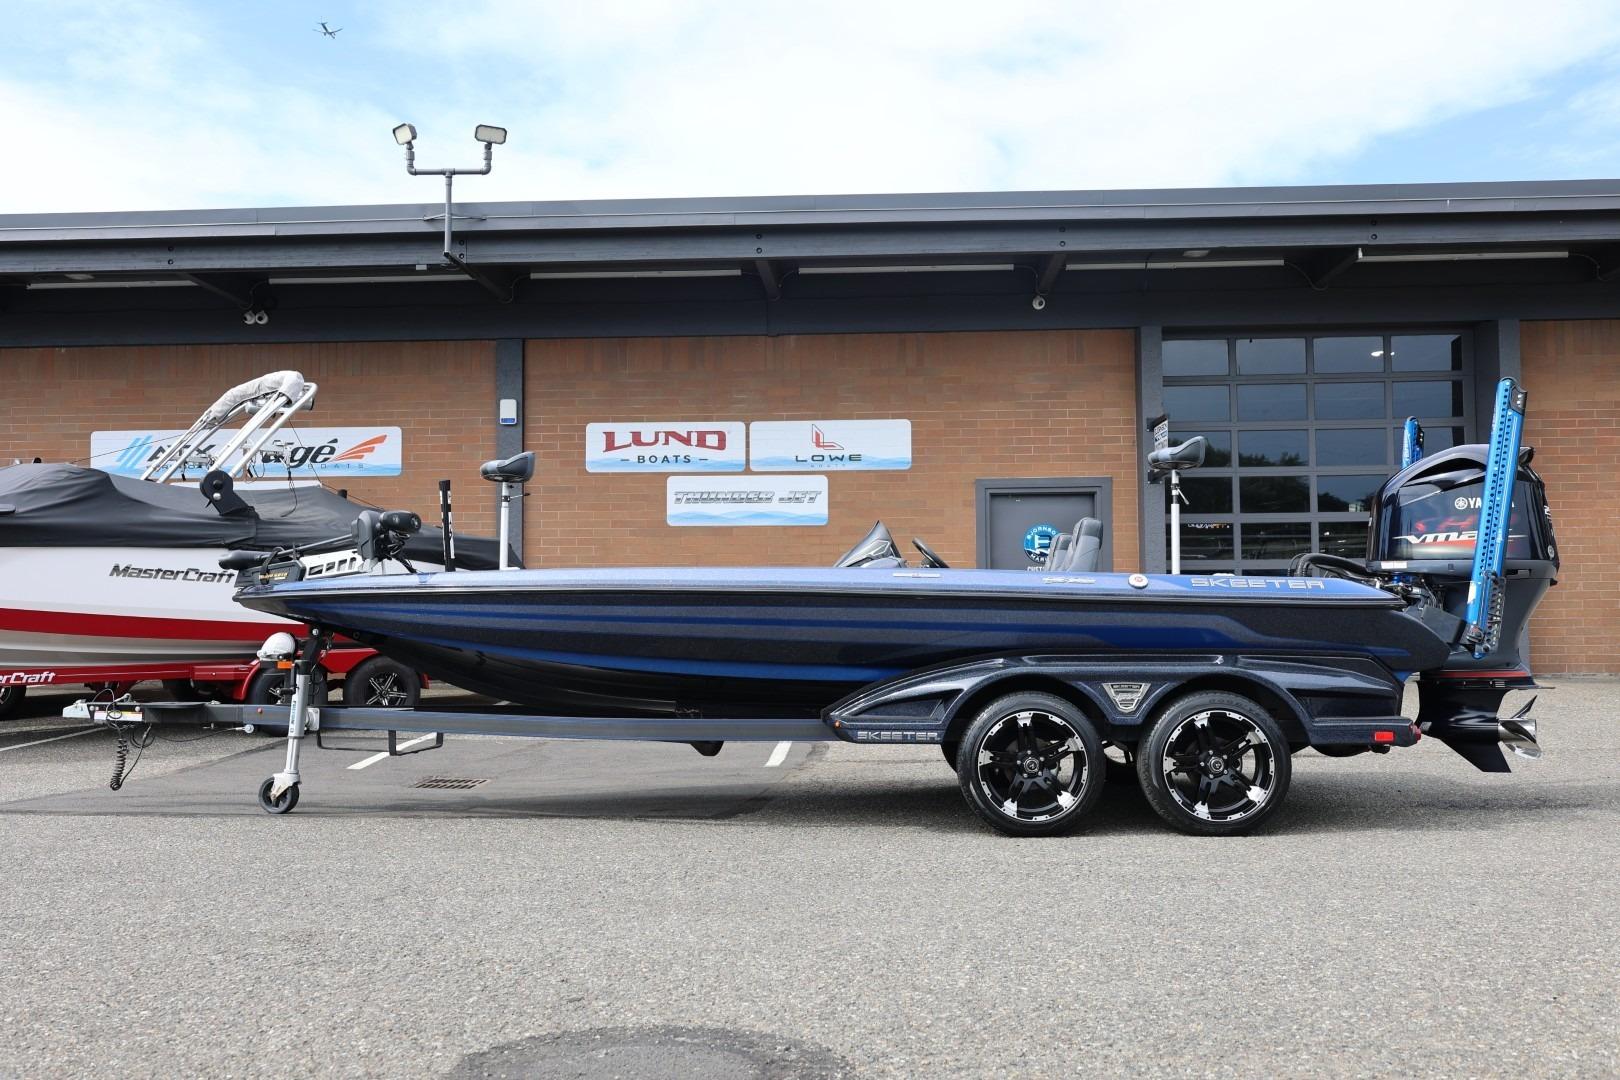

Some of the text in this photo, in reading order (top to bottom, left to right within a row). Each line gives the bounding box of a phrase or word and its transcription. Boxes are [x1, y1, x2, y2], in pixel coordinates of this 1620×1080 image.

[603, 431, 727, 452] LUND
[637, 455, 691, 463] BOATS
[795, 454, 862, 462] LOWE
[674, 491, 821, 504] THUNDER JET
[109, 562, 235, 584] MasterCraft
[1190, 577, 1325, 590] SKEETER
[857, 731, 938, 741] SKEETER
